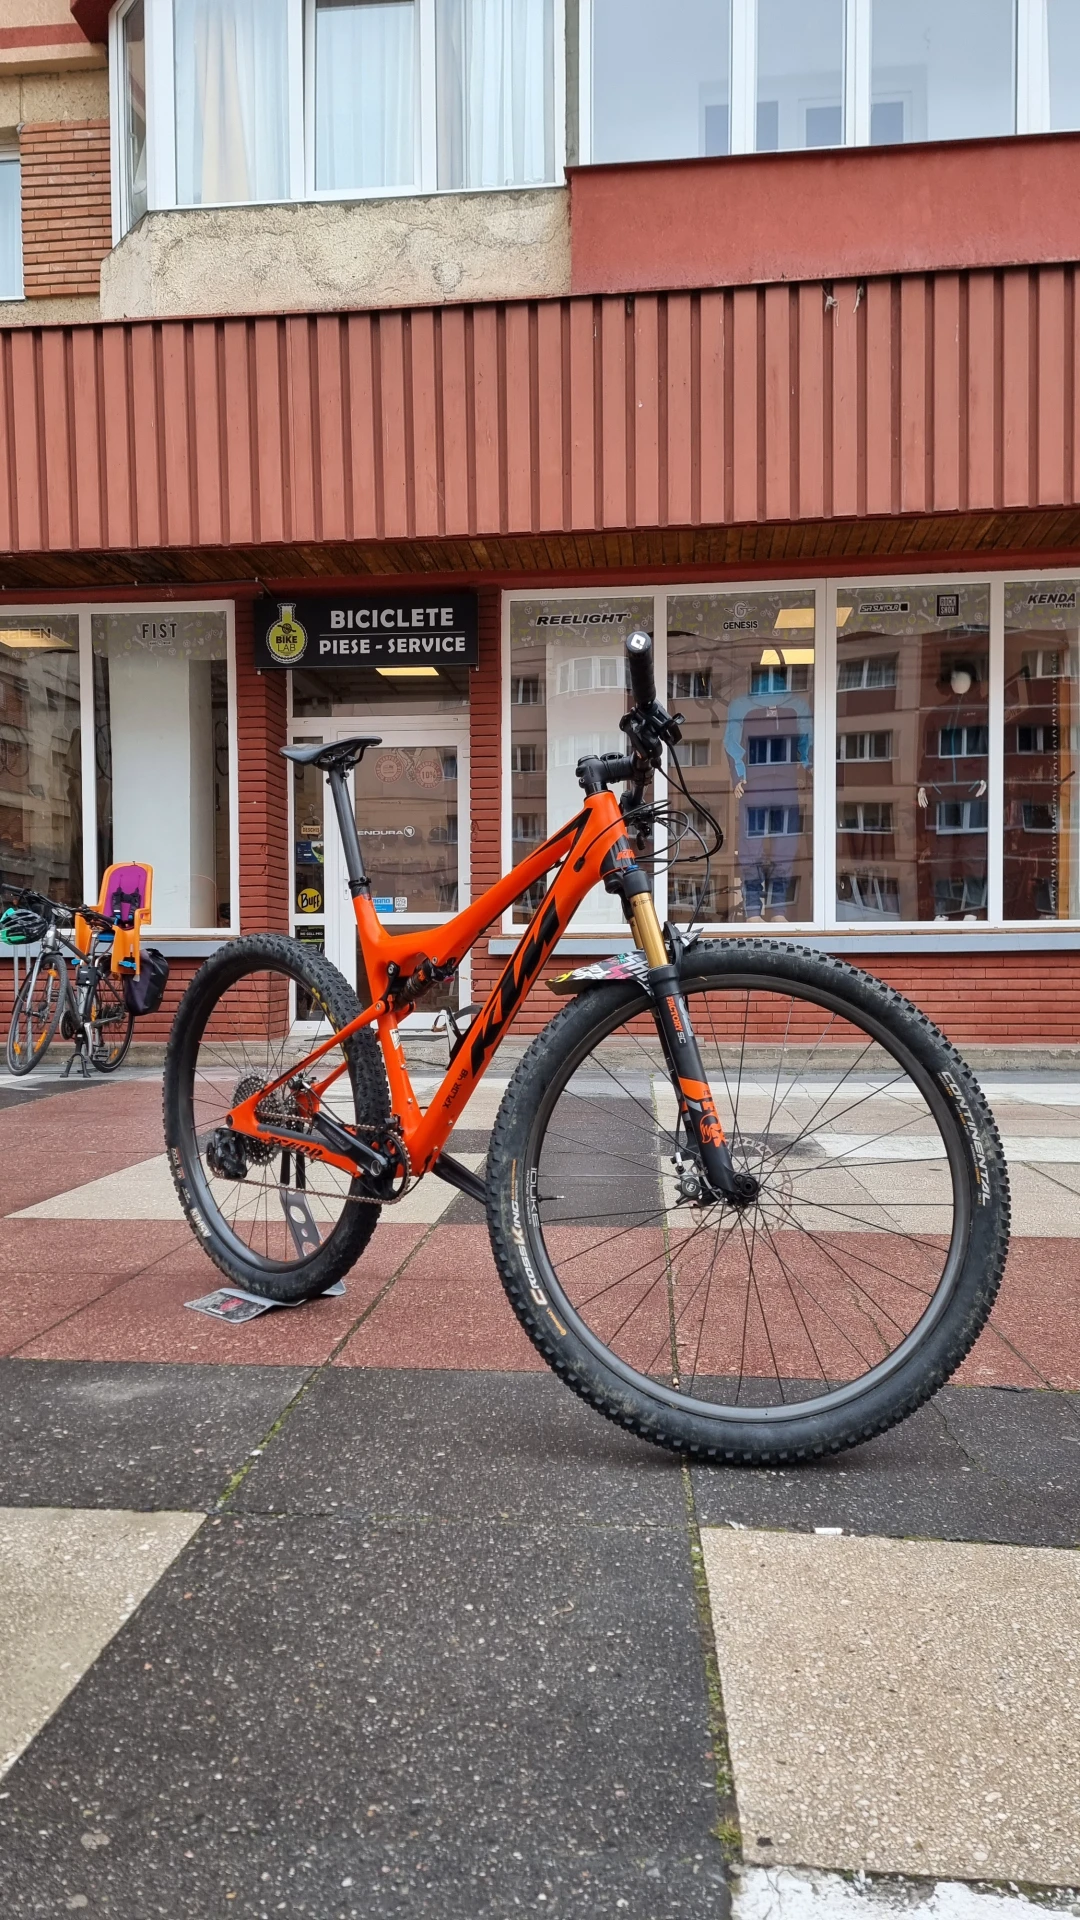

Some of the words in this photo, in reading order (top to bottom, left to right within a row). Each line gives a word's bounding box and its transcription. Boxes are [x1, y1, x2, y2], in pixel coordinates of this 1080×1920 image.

[1028, 593, 1075, 604] KENDA
[330, 608, 454, 629] BICICLETE
[537, 613, 627, 625] REELIGHT
[723, 621, 758, 629] GENESIS
[142, 623, 177, 638] FIST
[275, 635, 298, 644] BIKE
[319, 639, 371, 655] PIESE
[387, 636, 466, 654] SERVICE
[277, 644, 296, 652] LAB
[666, 996, 684, 1032] FACTORY
[677, 1031, 687, 1044] SC
[442, 1082, 462, 1109] XPLOR
[941, 1071, 991, 1206] CONTINENTAL
